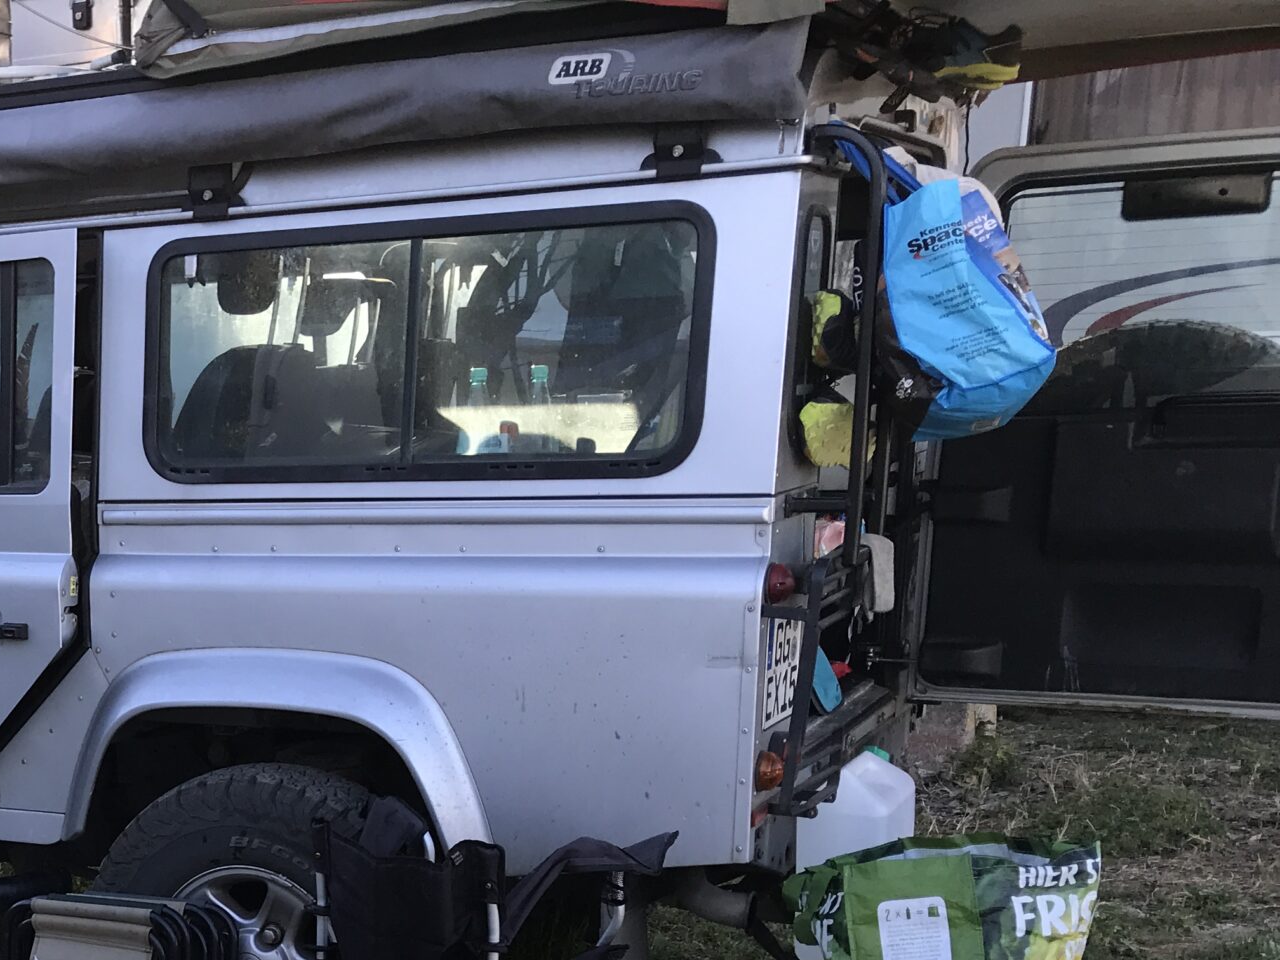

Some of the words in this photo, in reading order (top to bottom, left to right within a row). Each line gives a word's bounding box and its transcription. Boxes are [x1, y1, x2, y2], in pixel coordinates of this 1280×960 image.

[556, 58, 603, 78] ARB
[573, 69, 703, 99] TOURING
[1019, 863, 1079, 889] HIER
